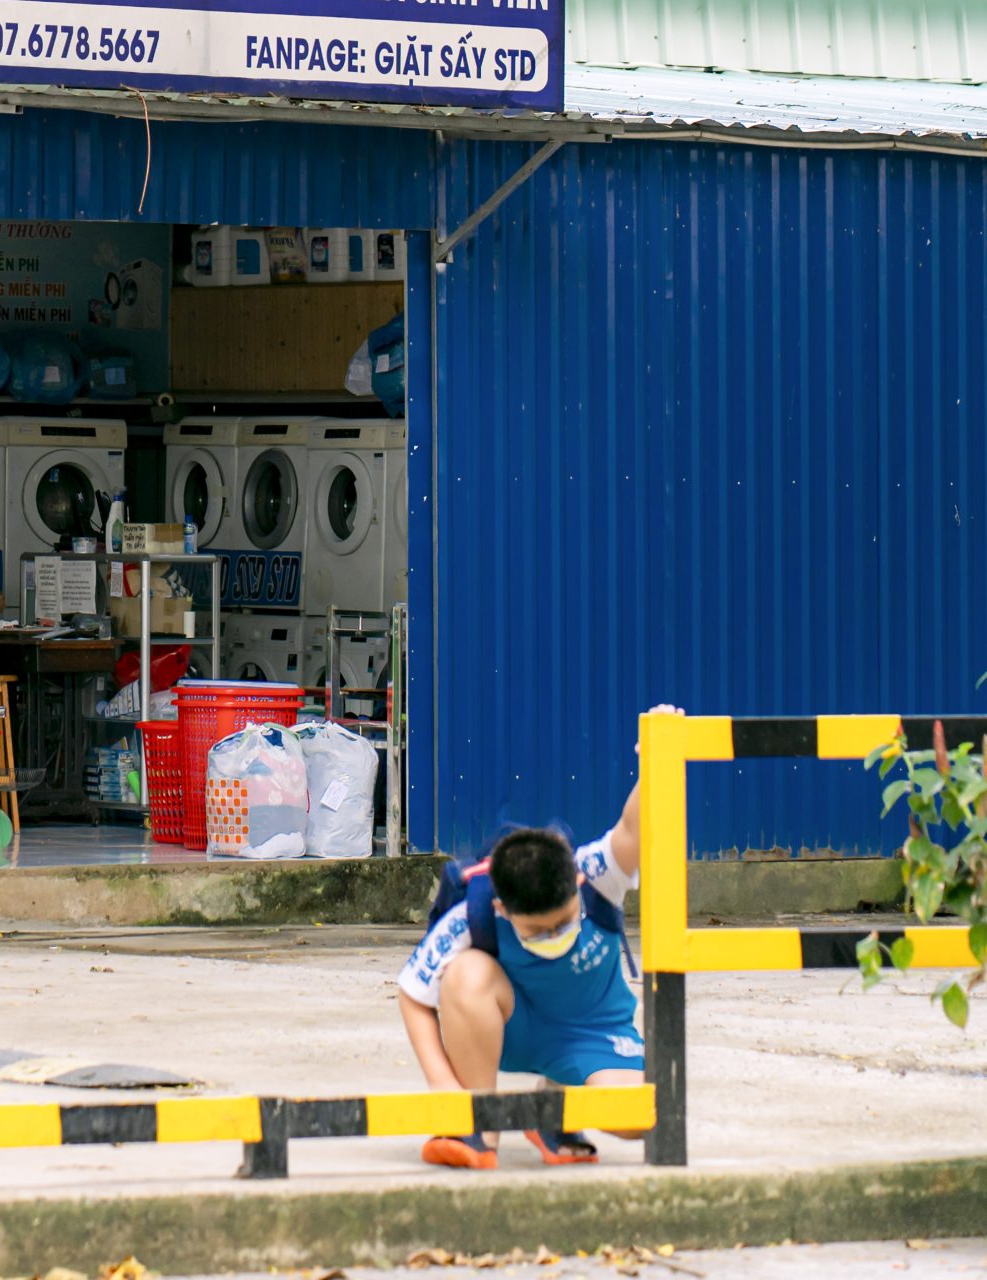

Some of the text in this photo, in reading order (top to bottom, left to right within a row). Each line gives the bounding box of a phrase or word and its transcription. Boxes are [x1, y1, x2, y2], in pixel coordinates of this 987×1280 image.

[247, 36, 365, 73] FANPAGE:
[372, 35, 436, 88] GIẶT
[441, 32, 486, 78] SẤY
[495, 49, 535, 81] STD
[267, 554, 300, 602] STD
